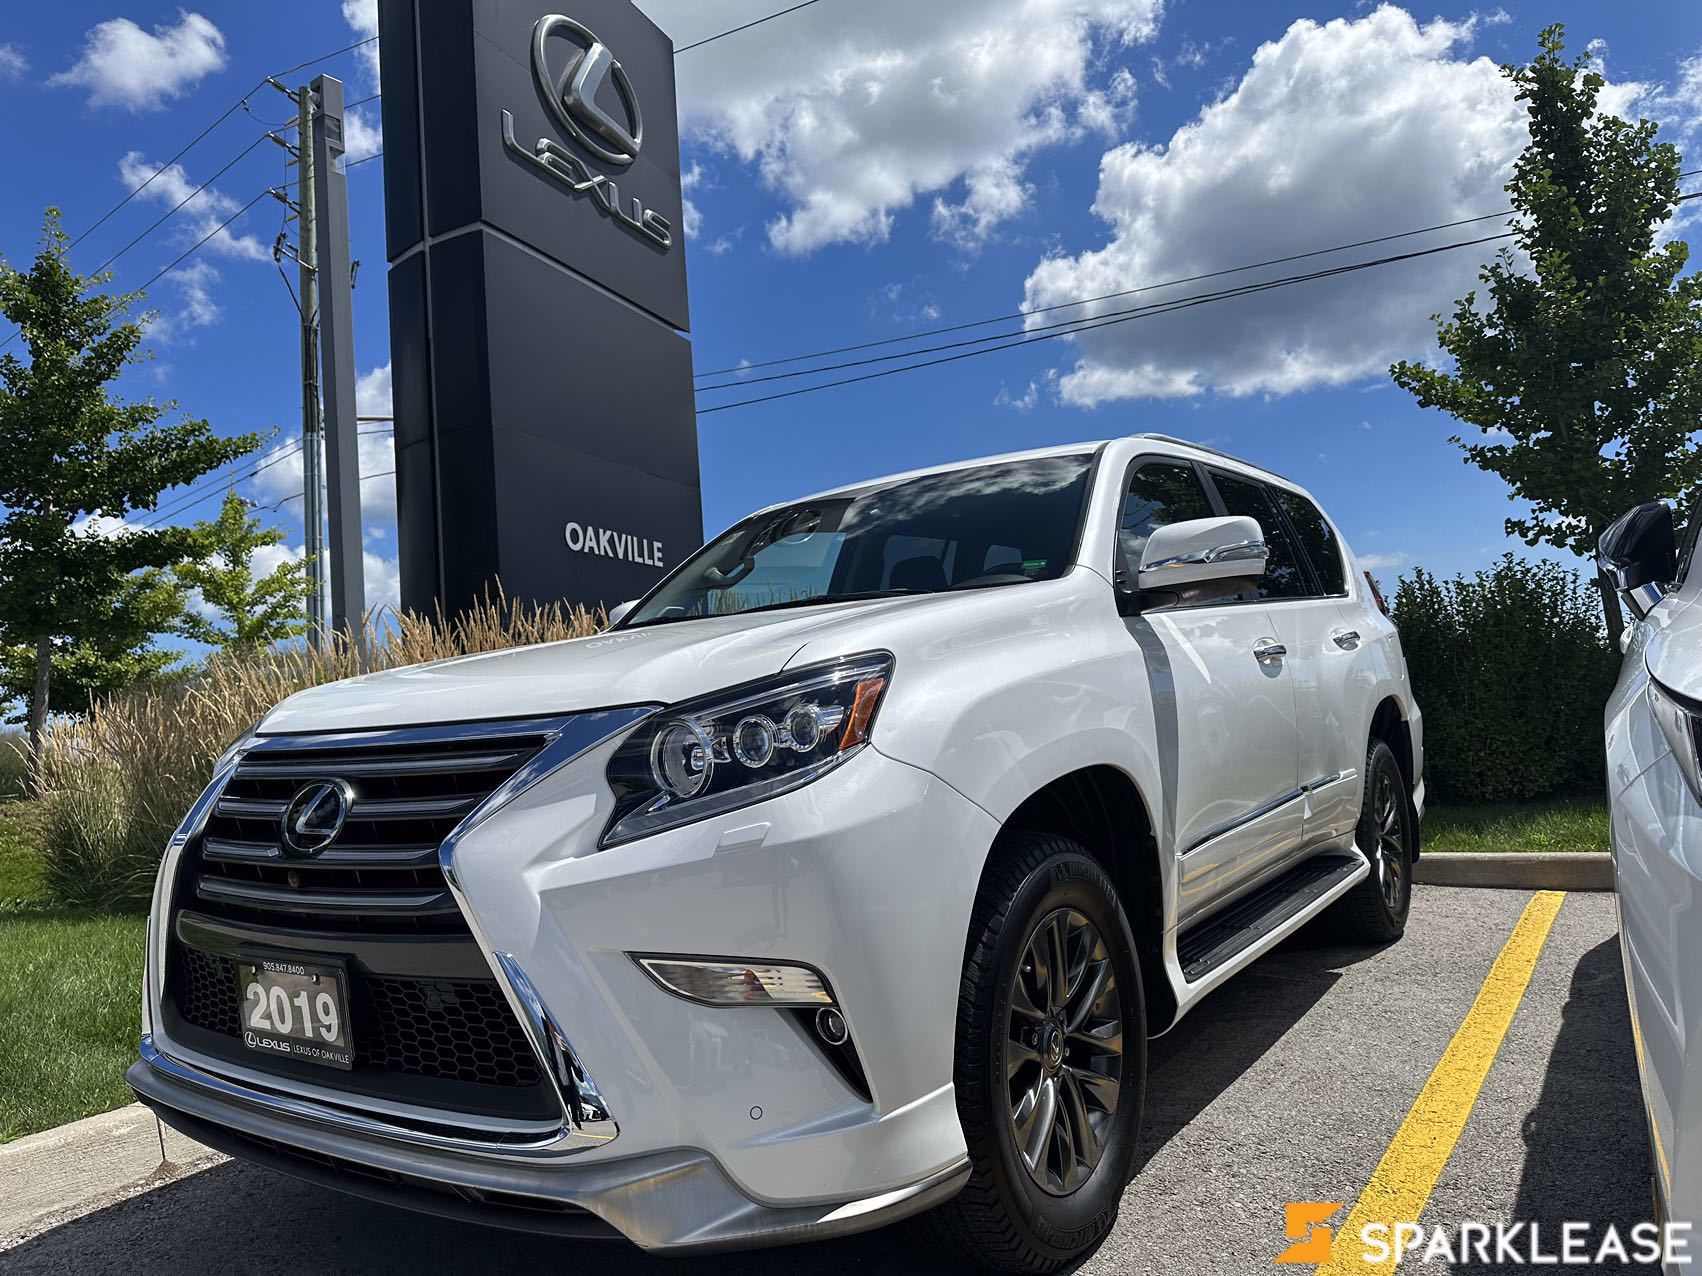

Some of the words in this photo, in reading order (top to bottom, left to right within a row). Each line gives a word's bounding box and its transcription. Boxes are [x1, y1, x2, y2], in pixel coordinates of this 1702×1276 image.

[501, 108, 672, 249] LEXUS
[565, 521, 664, 567] OAKVILLE
[246, 982, 339, 1042] 2019
[256, 1037, 291, 1052] LEXUS
[293, 1045, 311, 1056] LEXUS
[312, 1048, 320, 1057] OF
[321, 1050, 350, 1064] OAKVILLE
